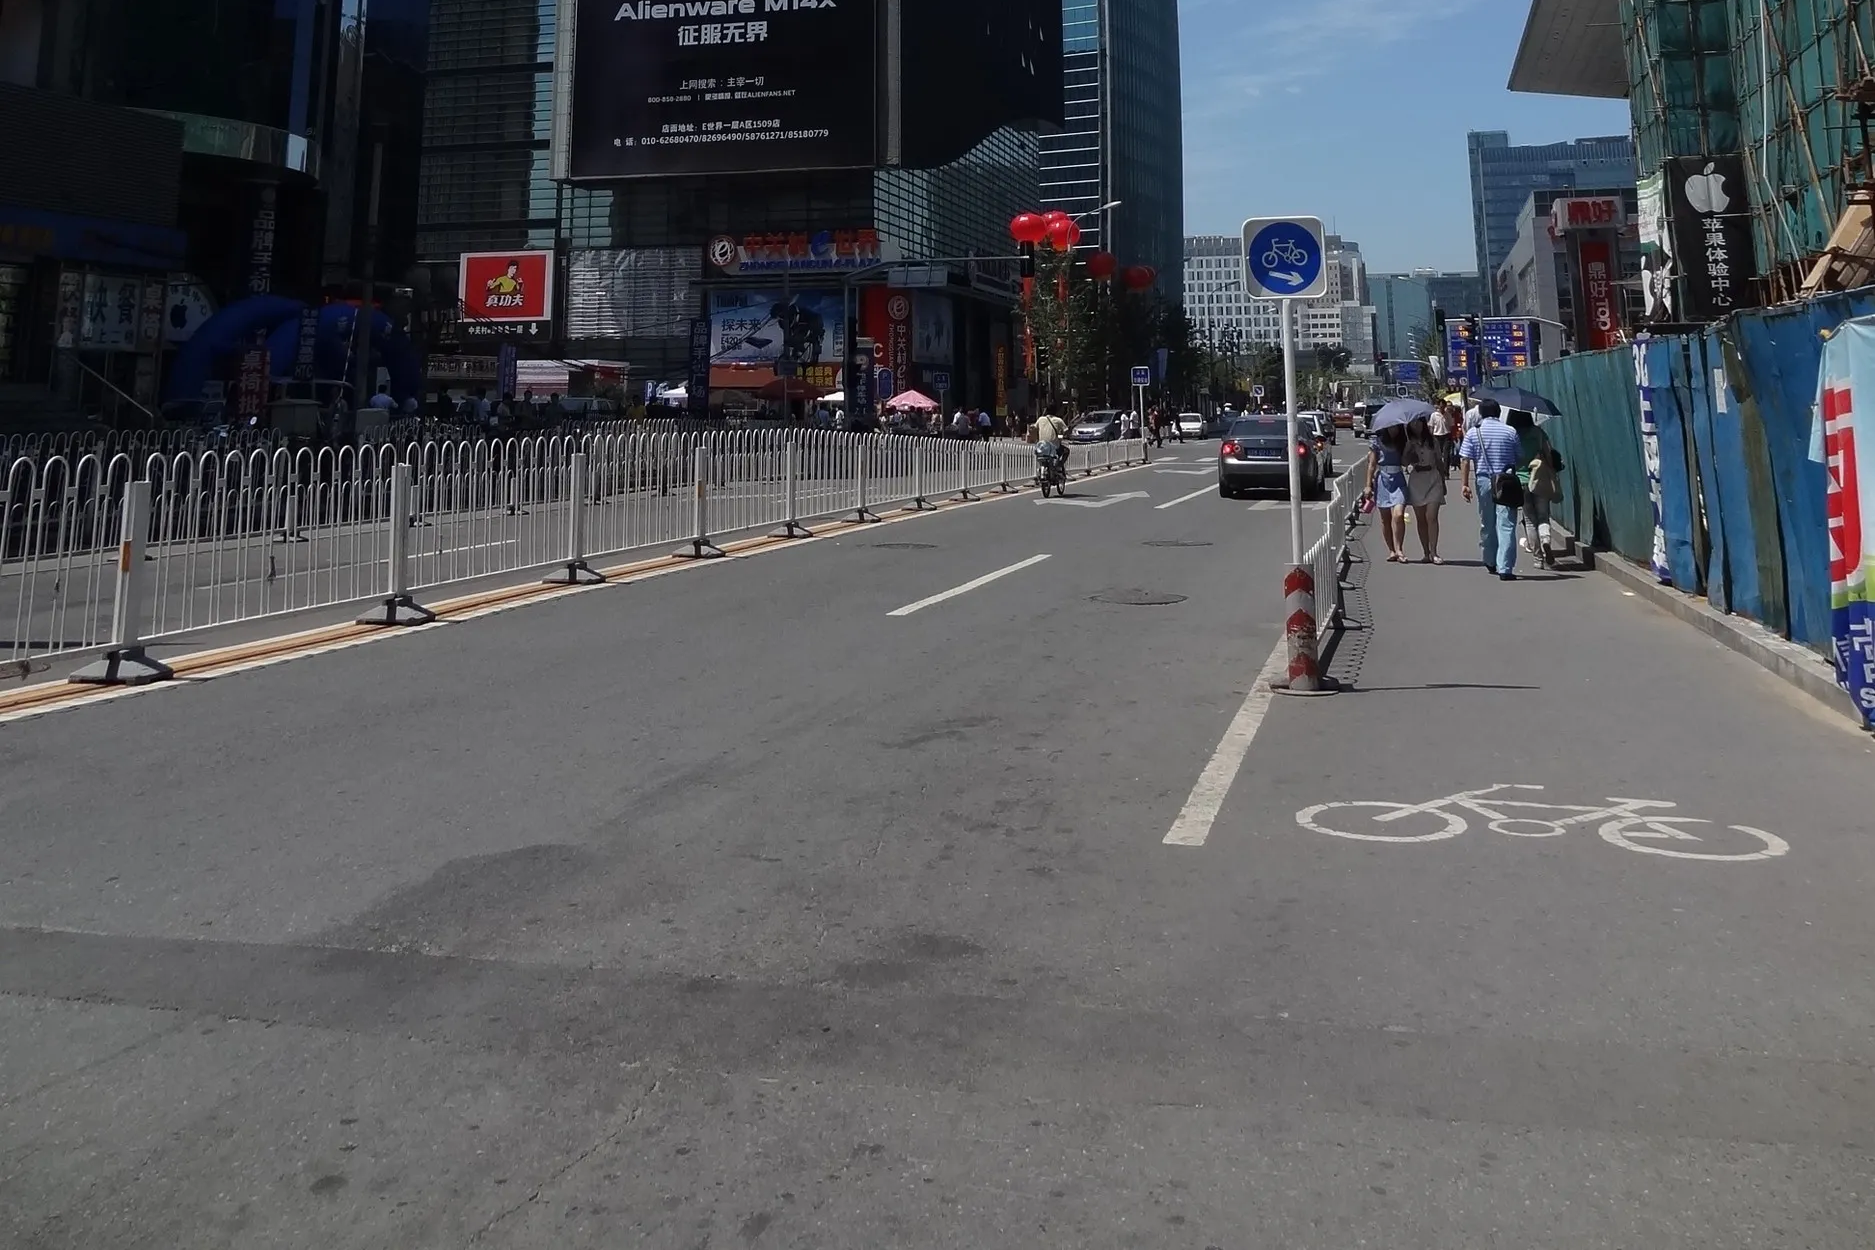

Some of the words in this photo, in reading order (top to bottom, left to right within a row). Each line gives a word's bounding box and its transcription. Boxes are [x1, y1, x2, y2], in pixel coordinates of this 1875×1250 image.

[677, 20, 769, 46] 征服无界
[1567, 200, 1618, 225] 鼎好
[1701, 217, 1733, 307] 苹果体验中心
[484, 293, 524, 307] 真功夫
[721, 317, 761, 332] 探未来
[896, 323, 907, 395] 中关村e世
[238, 349, 263, 417] 桌椅批
